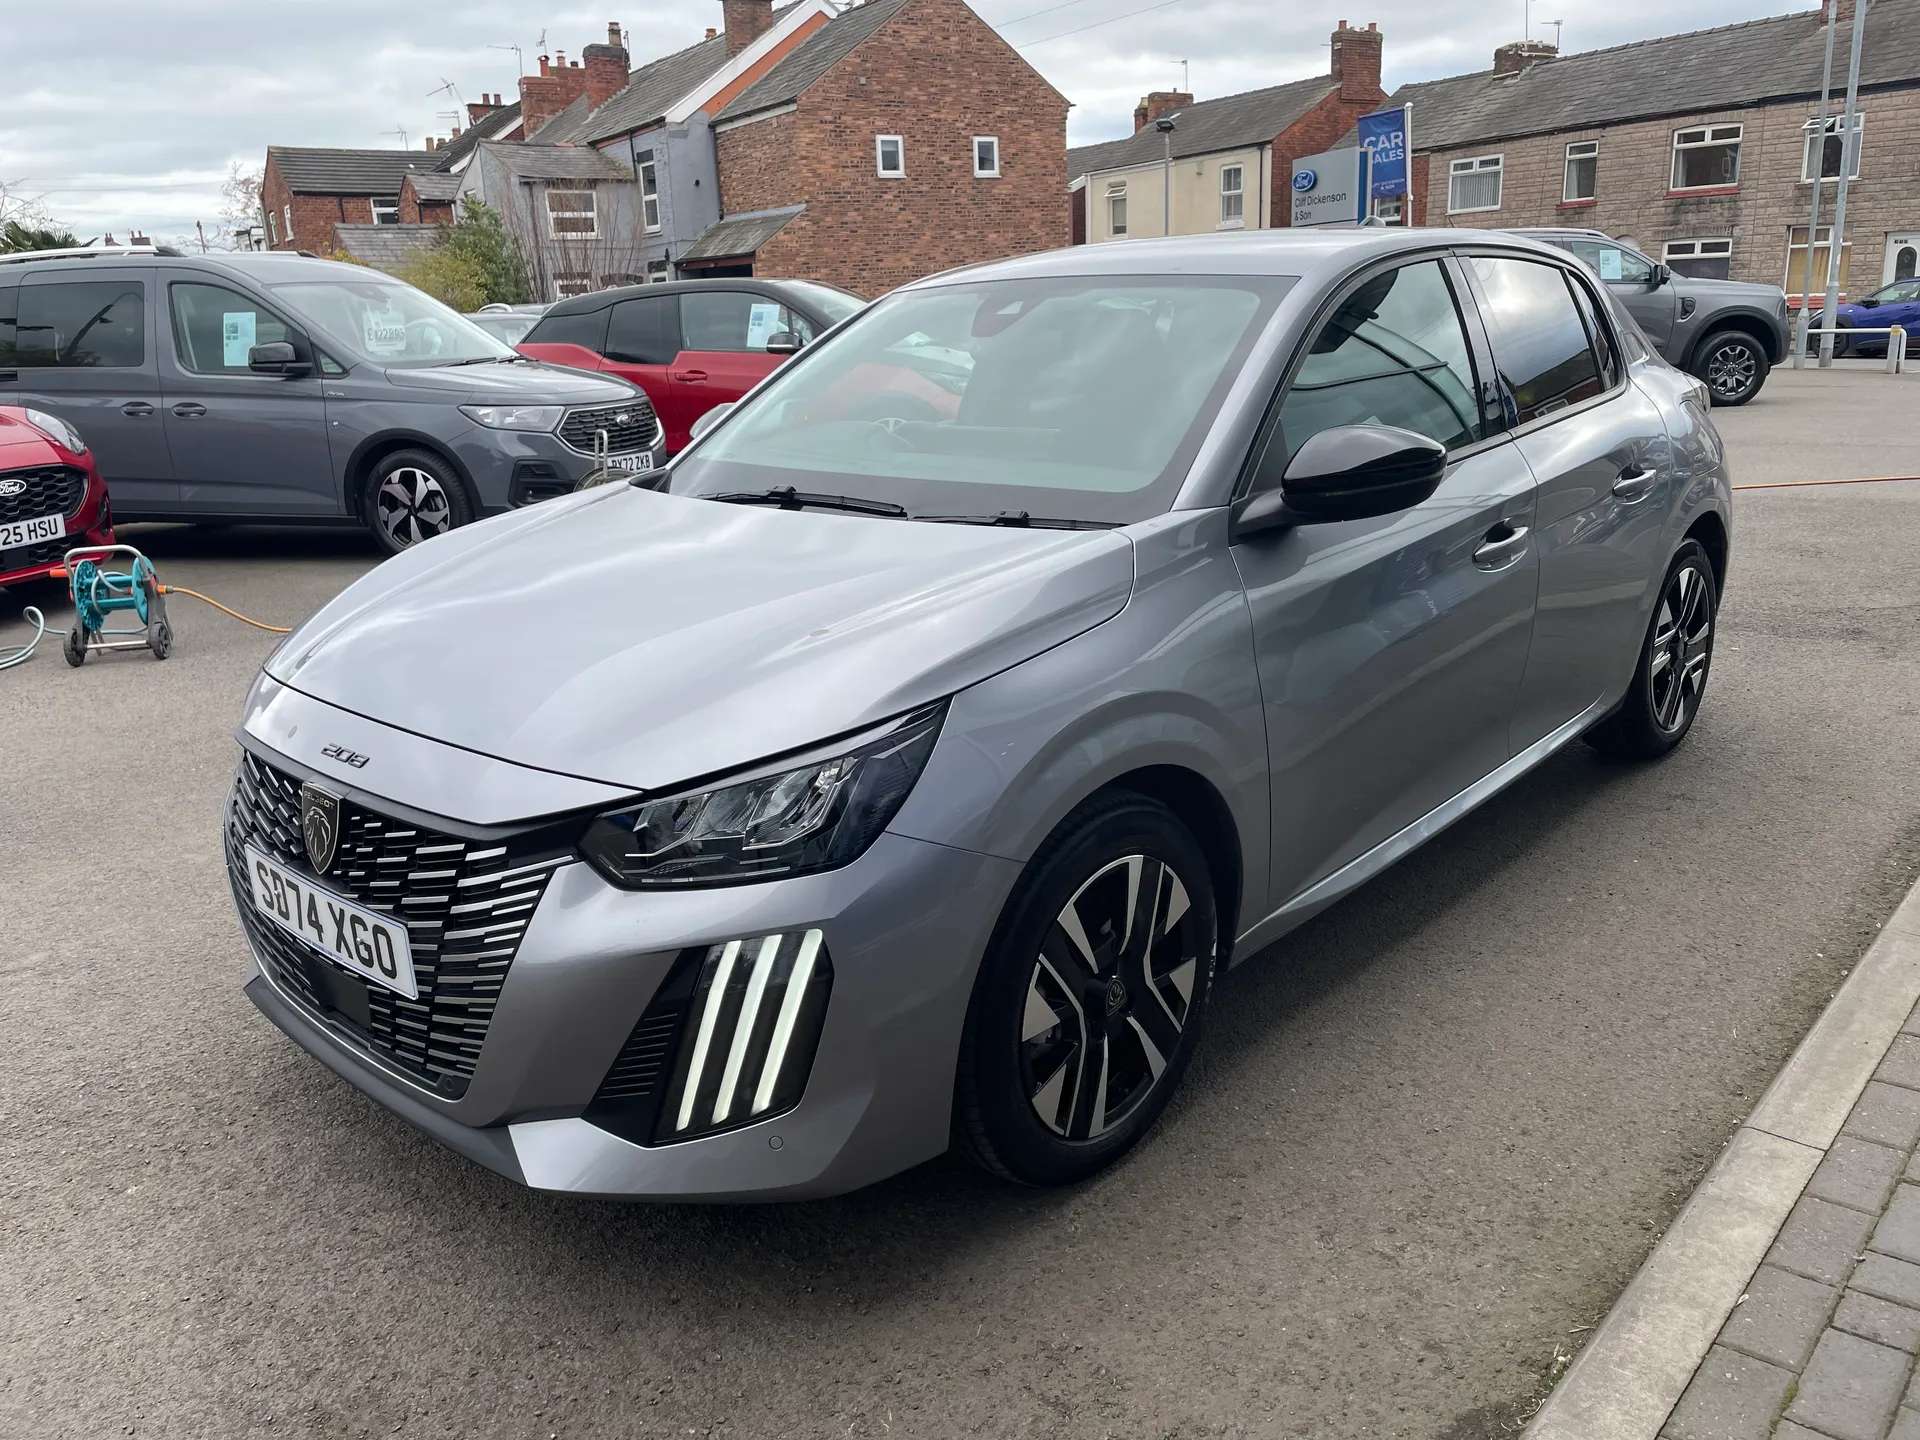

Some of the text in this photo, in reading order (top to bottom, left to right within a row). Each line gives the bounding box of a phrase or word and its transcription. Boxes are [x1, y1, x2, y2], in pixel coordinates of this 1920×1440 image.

[1363, 131, 1404, 150] CAR
[1372, 149, 1405, 165] ALES
[1307, 192, 1347, 206] Dickenson
[1295, 209, 1312, 221] & Son
[635, 454, 651, 470] ZKB
[0, 481, 21, 494] Ford
[0, 518, 58, 546] 25 HSU
[320, 743, 370, 769] 208
[256, 860, 324, 944] SD74
[328, 902, 397, 980] XGO
